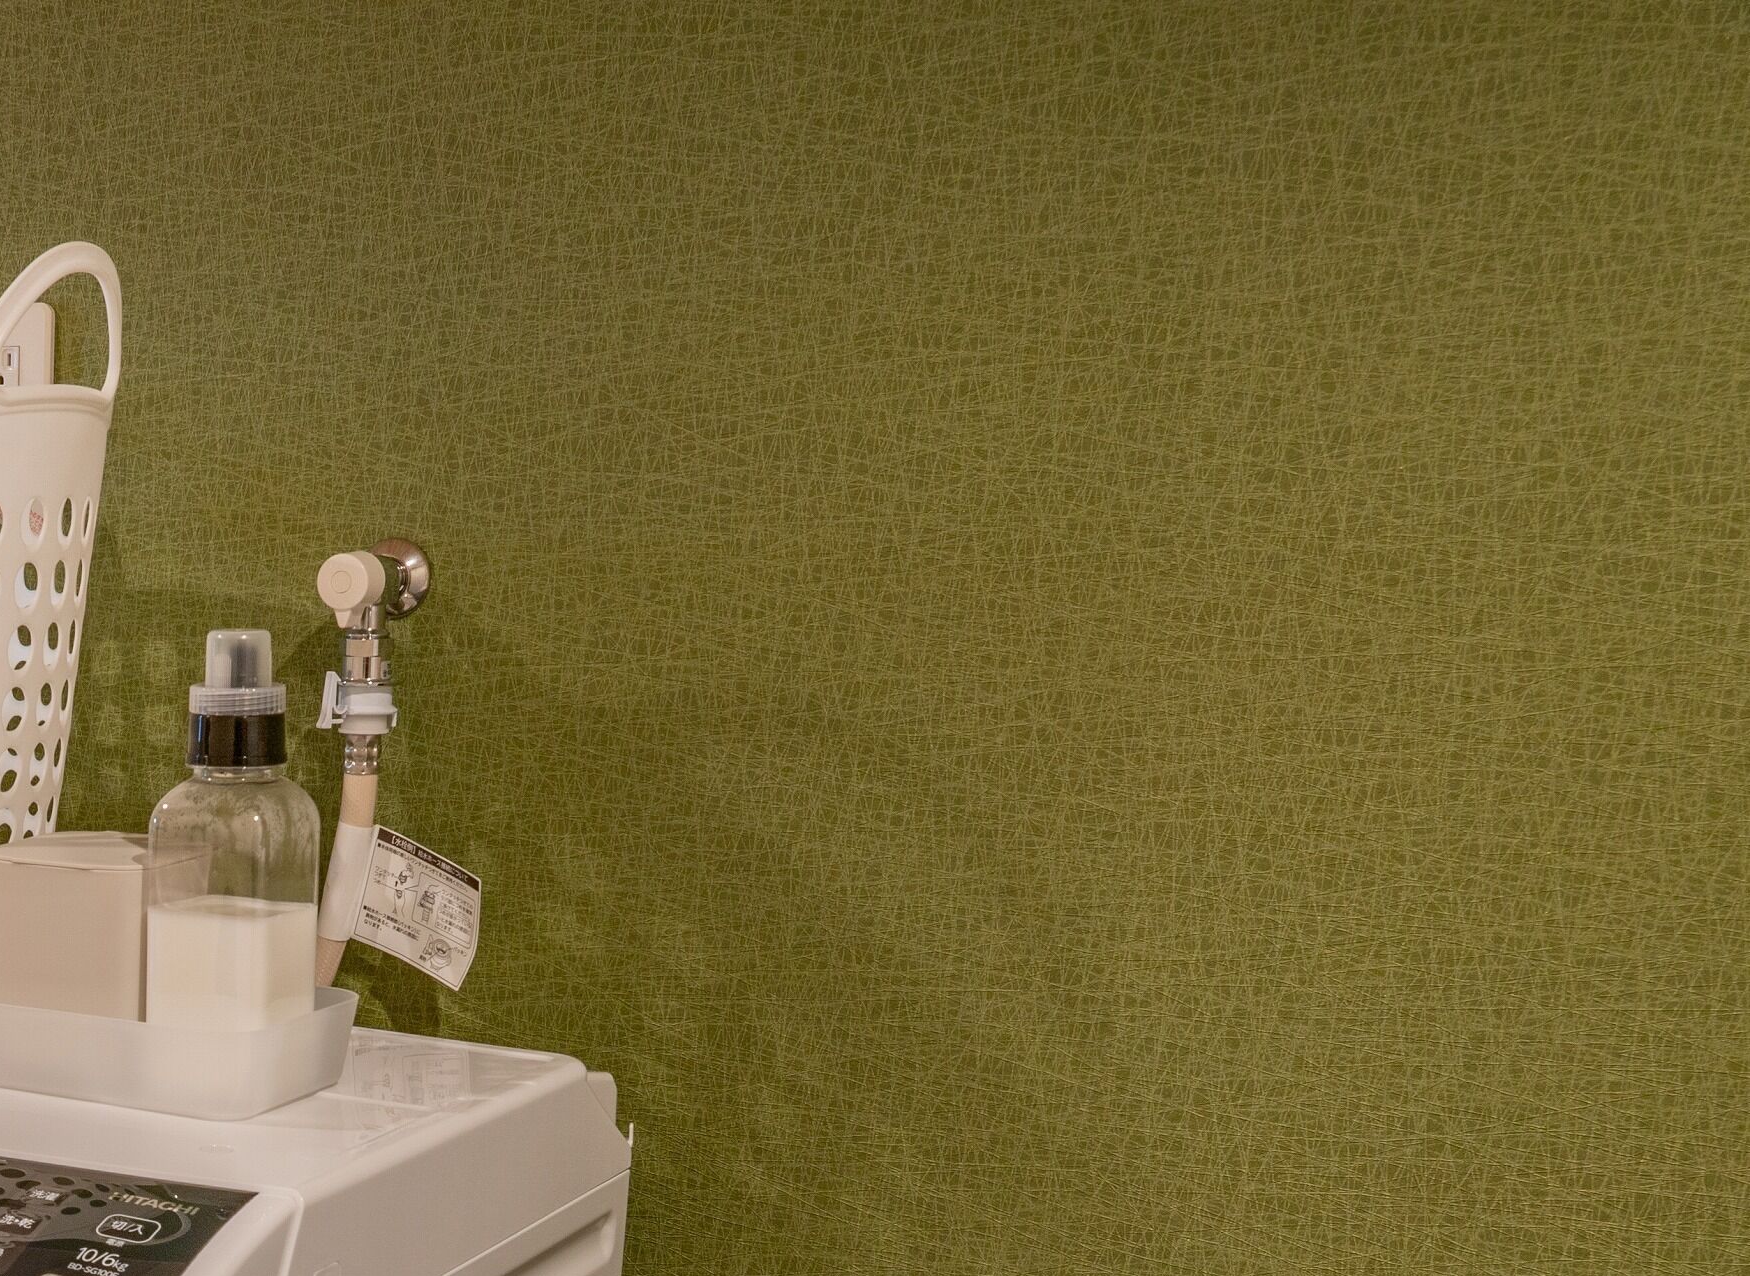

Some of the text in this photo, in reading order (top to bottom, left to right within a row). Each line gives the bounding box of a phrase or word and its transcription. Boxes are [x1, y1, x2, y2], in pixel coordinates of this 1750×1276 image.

[109, 1192, 200, 1216] HITACHI
[111, 1220, 144, 1236] 切/入
[75, 1247, 130, 1272] 10/6kg
